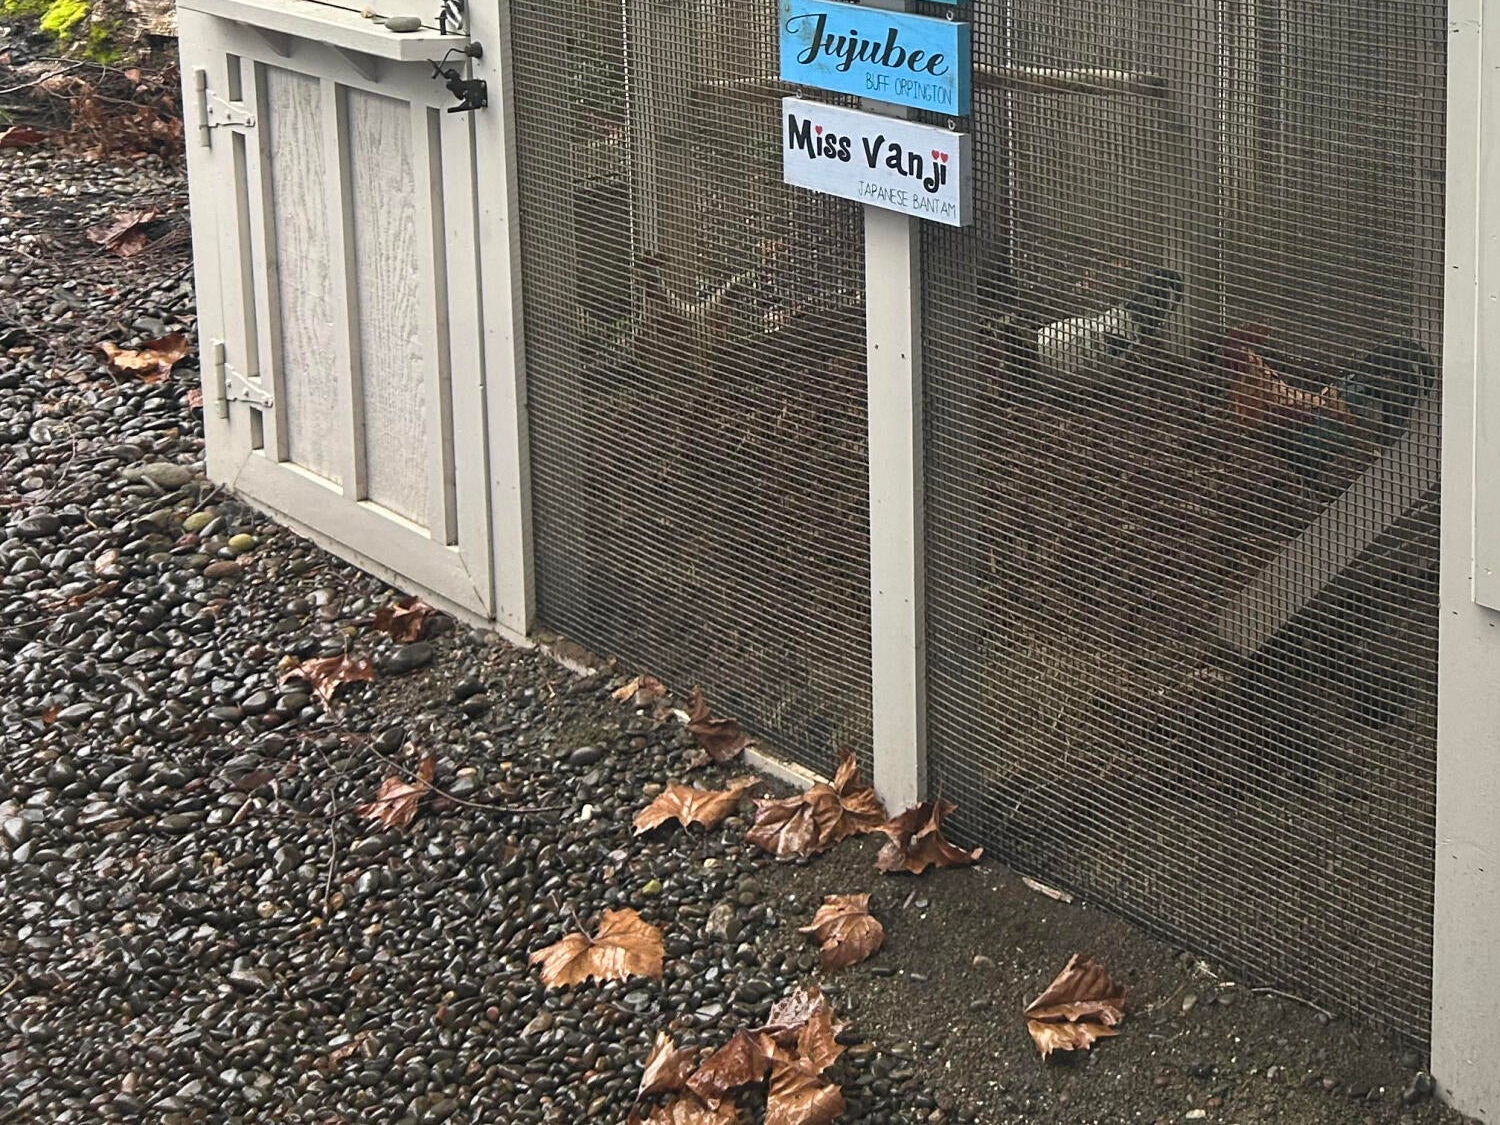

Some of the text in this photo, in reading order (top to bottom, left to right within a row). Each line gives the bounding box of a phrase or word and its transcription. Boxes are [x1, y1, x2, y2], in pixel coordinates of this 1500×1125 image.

[786, 14, 949, 76] Jujubee
[866, 72, 951, 105] BUFF ORPINGTON
[788, 114, 948, 192] Miss Vanji
[858, 181, 956, 220] JAPANESE BANTAM
